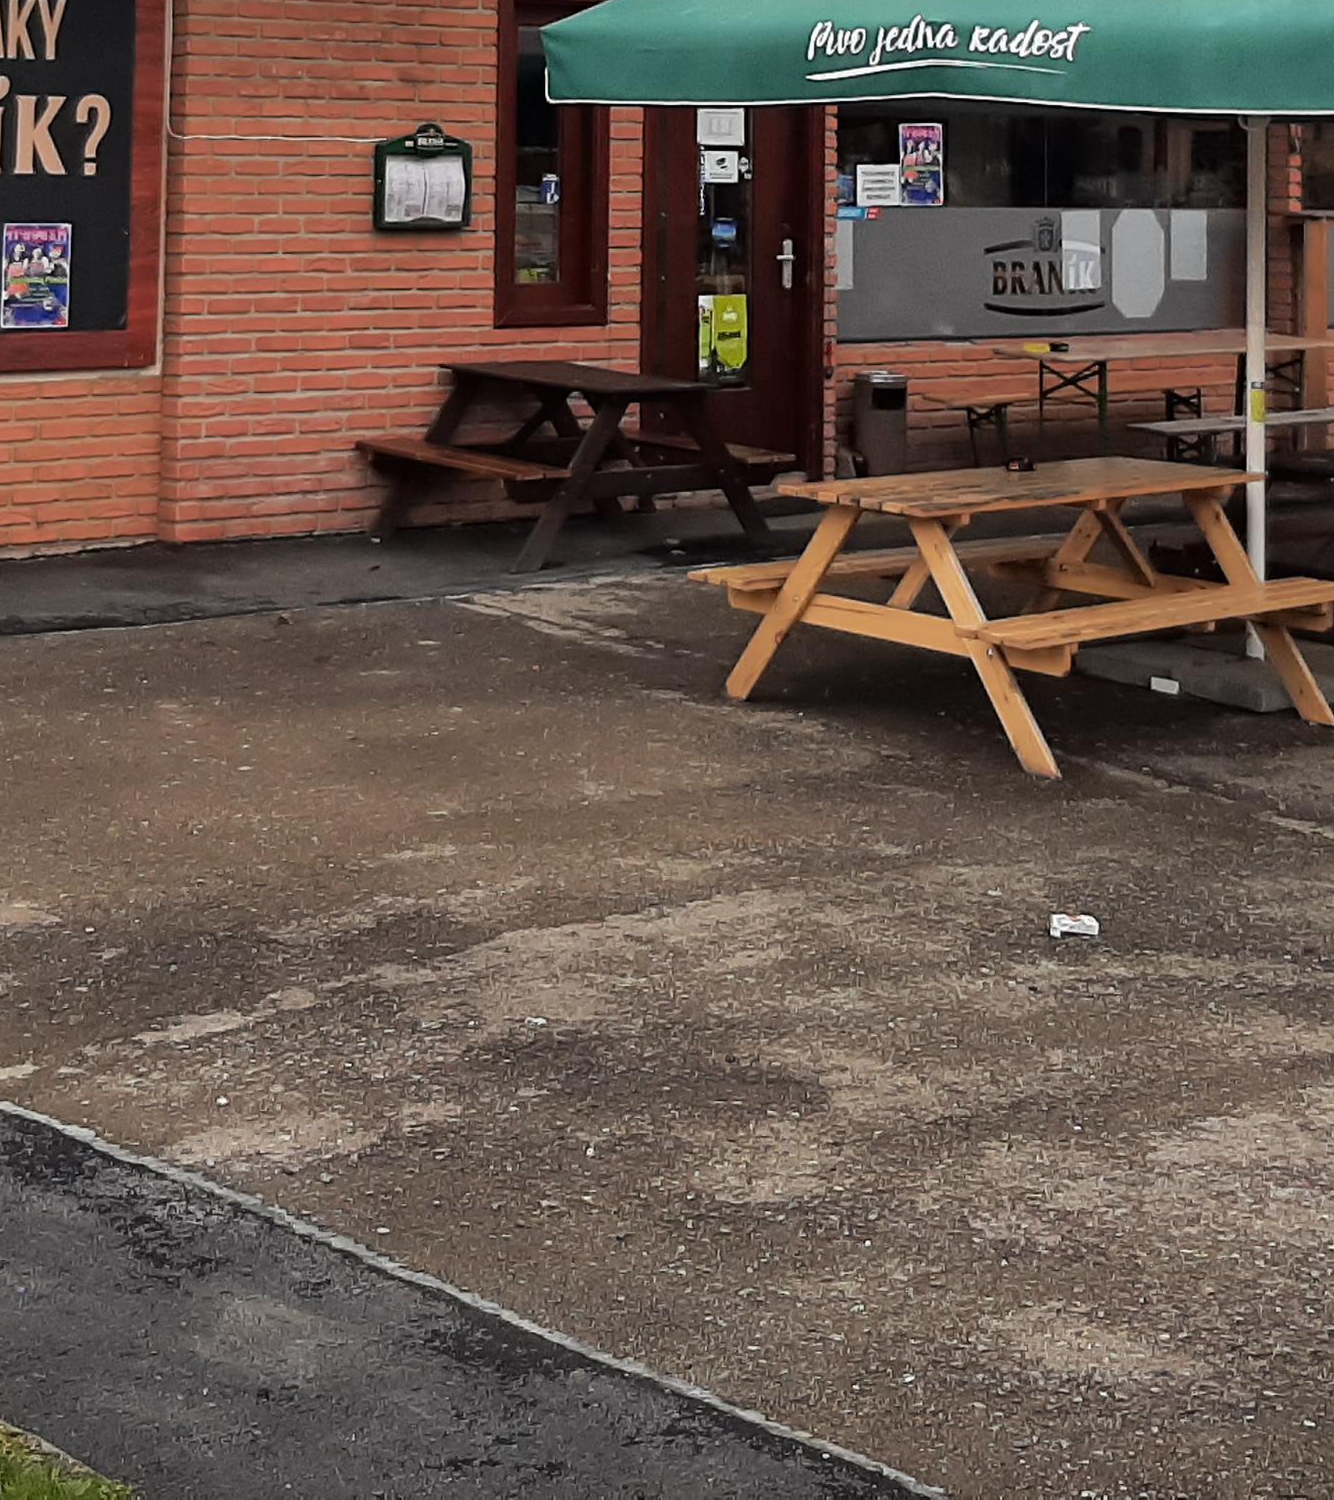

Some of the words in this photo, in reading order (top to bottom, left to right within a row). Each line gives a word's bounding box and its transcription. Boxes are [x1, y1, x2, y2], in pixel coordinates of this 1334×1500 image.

[869, 14, 960, 66] jedna
[969, 19, 1091, 62] radost
[991, 252, 1099, 296] BRANÍK
